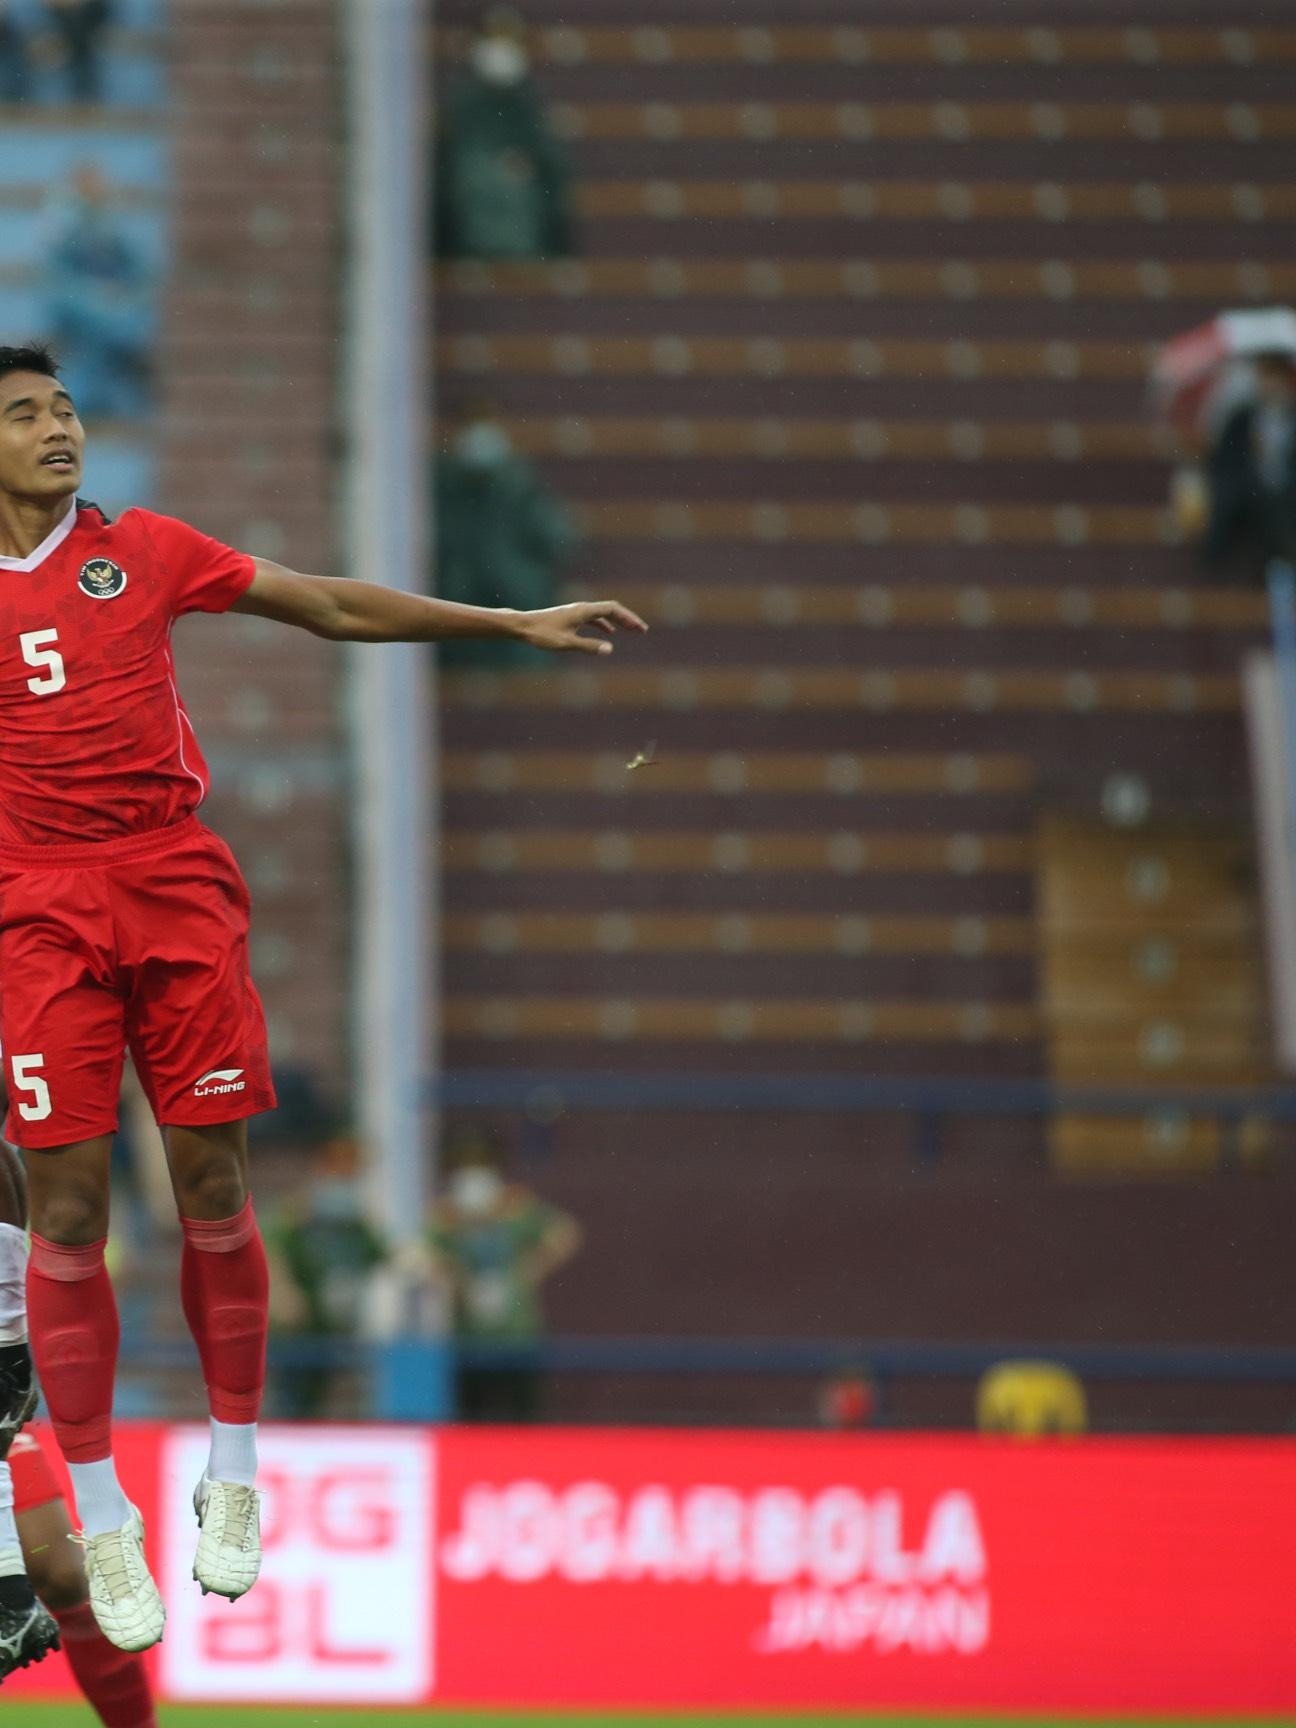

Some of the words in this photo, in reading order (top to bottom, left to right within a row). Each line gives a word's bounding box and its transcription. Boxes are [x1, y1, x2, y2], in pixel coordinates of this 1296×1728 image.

[19, 627, 66, 695] 5
[11, 1053, 53, 1121] 5
[193, 1081, 245, 1097] LI-NING
[443, 1480, 987, 1584] JOGARBOLA
[751, 1584, 991, 1653] JAPAN
